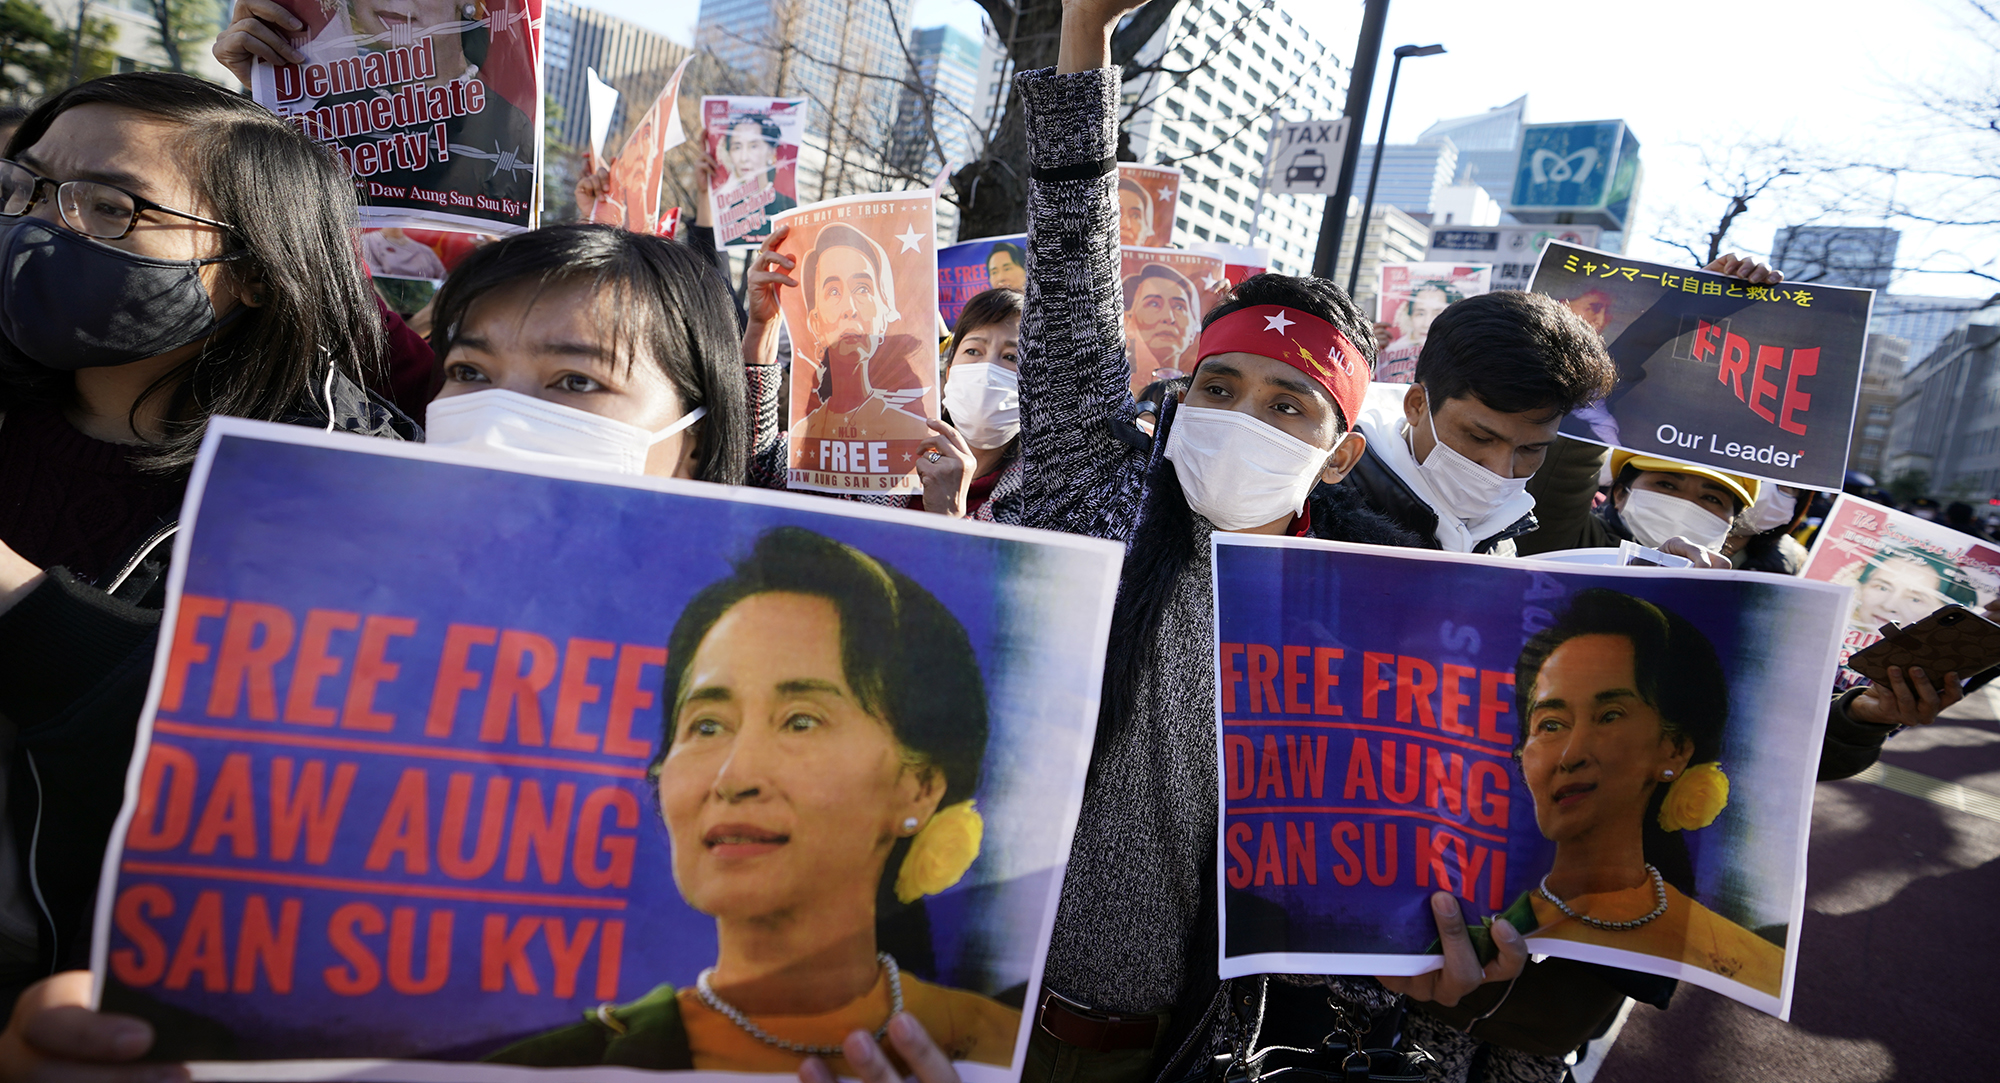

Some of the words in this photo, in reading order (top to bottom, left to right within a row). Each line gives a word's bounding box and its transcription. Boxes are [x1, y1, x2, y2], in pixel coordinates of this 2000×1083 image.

[272, 36, 437, 103] Demand
[1287, 124, 1343, 145] TAXI
[370, 182, 406, 198] Daw
[410, 186, 448, 206] Aung
[449, 191, 474, 207] San
[477, 195, 500, 211] Suu
[502, 199, 521, 217] Kyi
[794, 214, 809, 226] THE
[813, 209, 833, 223] WAY
[837, 206, 851, 218] WE
[858, 203, 895, 216] TRUST
[938, 267, 954, 284] EE
[954, 263, 989, 283] FREE
[1563, 254, 1814, 308] ミャンマーに自由と救いを
[1328, 346, 1355, 377] NLD
[1692, 319, 1821, 436] FREE
[820, 440, 889, 473] FREE
[838, 426, 857, 438] NLD
[1656, 424, 1704, 450] Our
[1709, 434, 1803, 469] Leader
[815, 473, 838, 487] AUNG
[844, 476, 870, 489] SAN
[879, 476, 910, 489] SUU
[160, 594, 417, 733] FREE
[425, 623, 668, 759] FREE
[1220, 643, 1345, 717] FREE
[1362, 651, 1516, 746] FREE
[1224, 734, 1329, 800] DAW
[1344, 737, 1510, 830] AUNG
[126, 743, 359, 866] DAW
[365, 768, 640, 889] AUNG
[1226, 821, 1318, 890] SAN
[1330, 821, 1398, 887] SU
[1415, 827, 1507, 911] KYI
[110, 883, 303, 994] SAN
[323, 902, 455, 995] SU
[480, 914, 626, 1001] KYI
